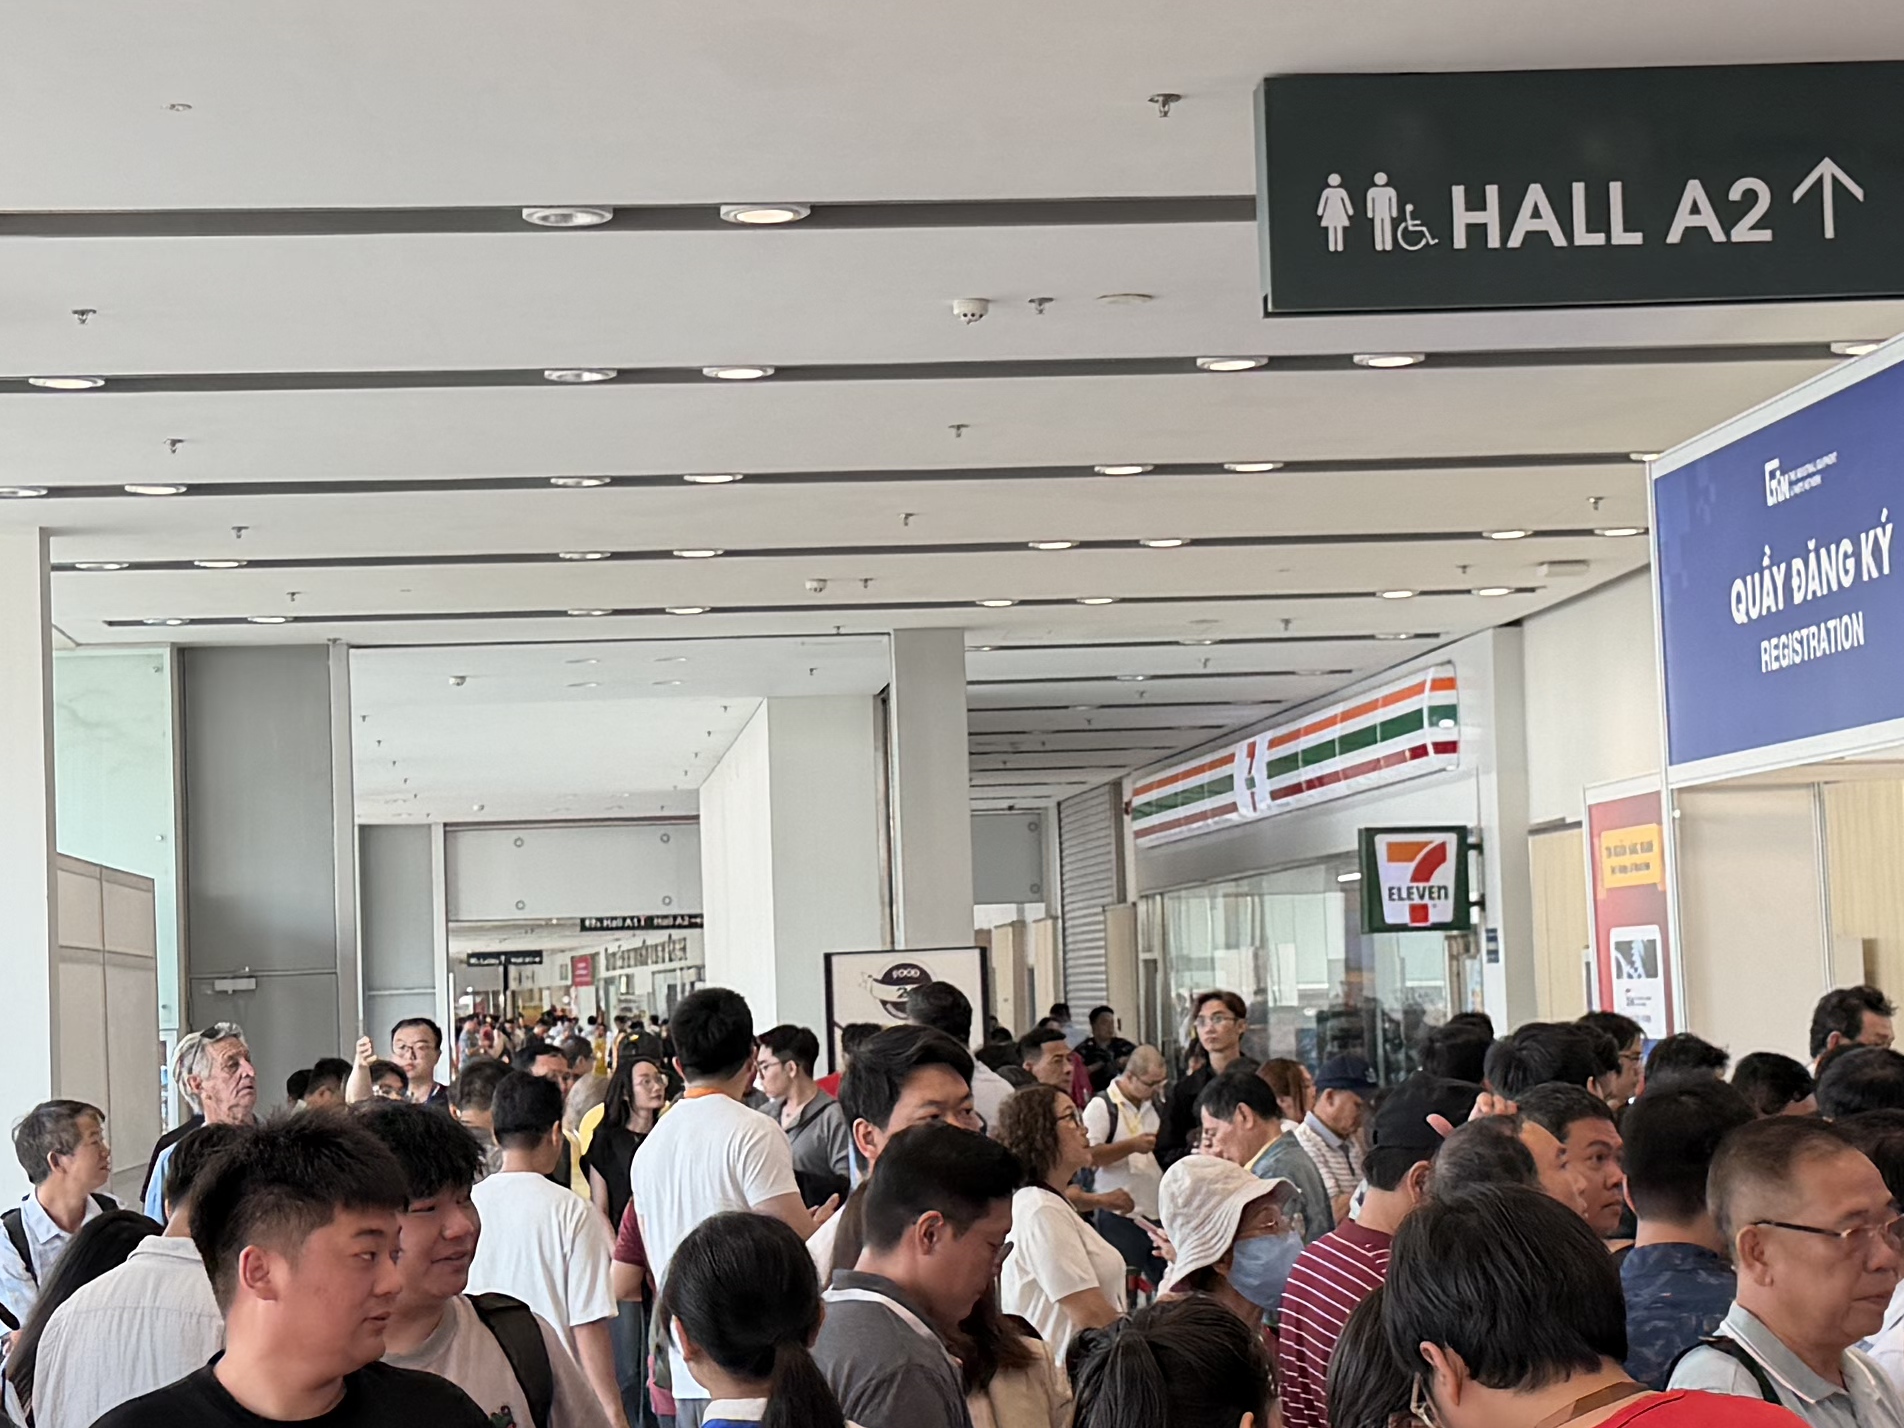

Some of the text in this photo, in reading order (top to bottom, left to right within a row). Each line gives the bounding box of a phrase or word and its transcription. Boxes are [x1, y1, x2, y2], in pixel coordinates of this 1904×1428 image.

[1452, 176, 1773, 249] HALL A2
[1730, 507, 1894, 625] QUẦY ĐĂNG KÝ
[1760, 610, 1865, 673] REGISTRATION
